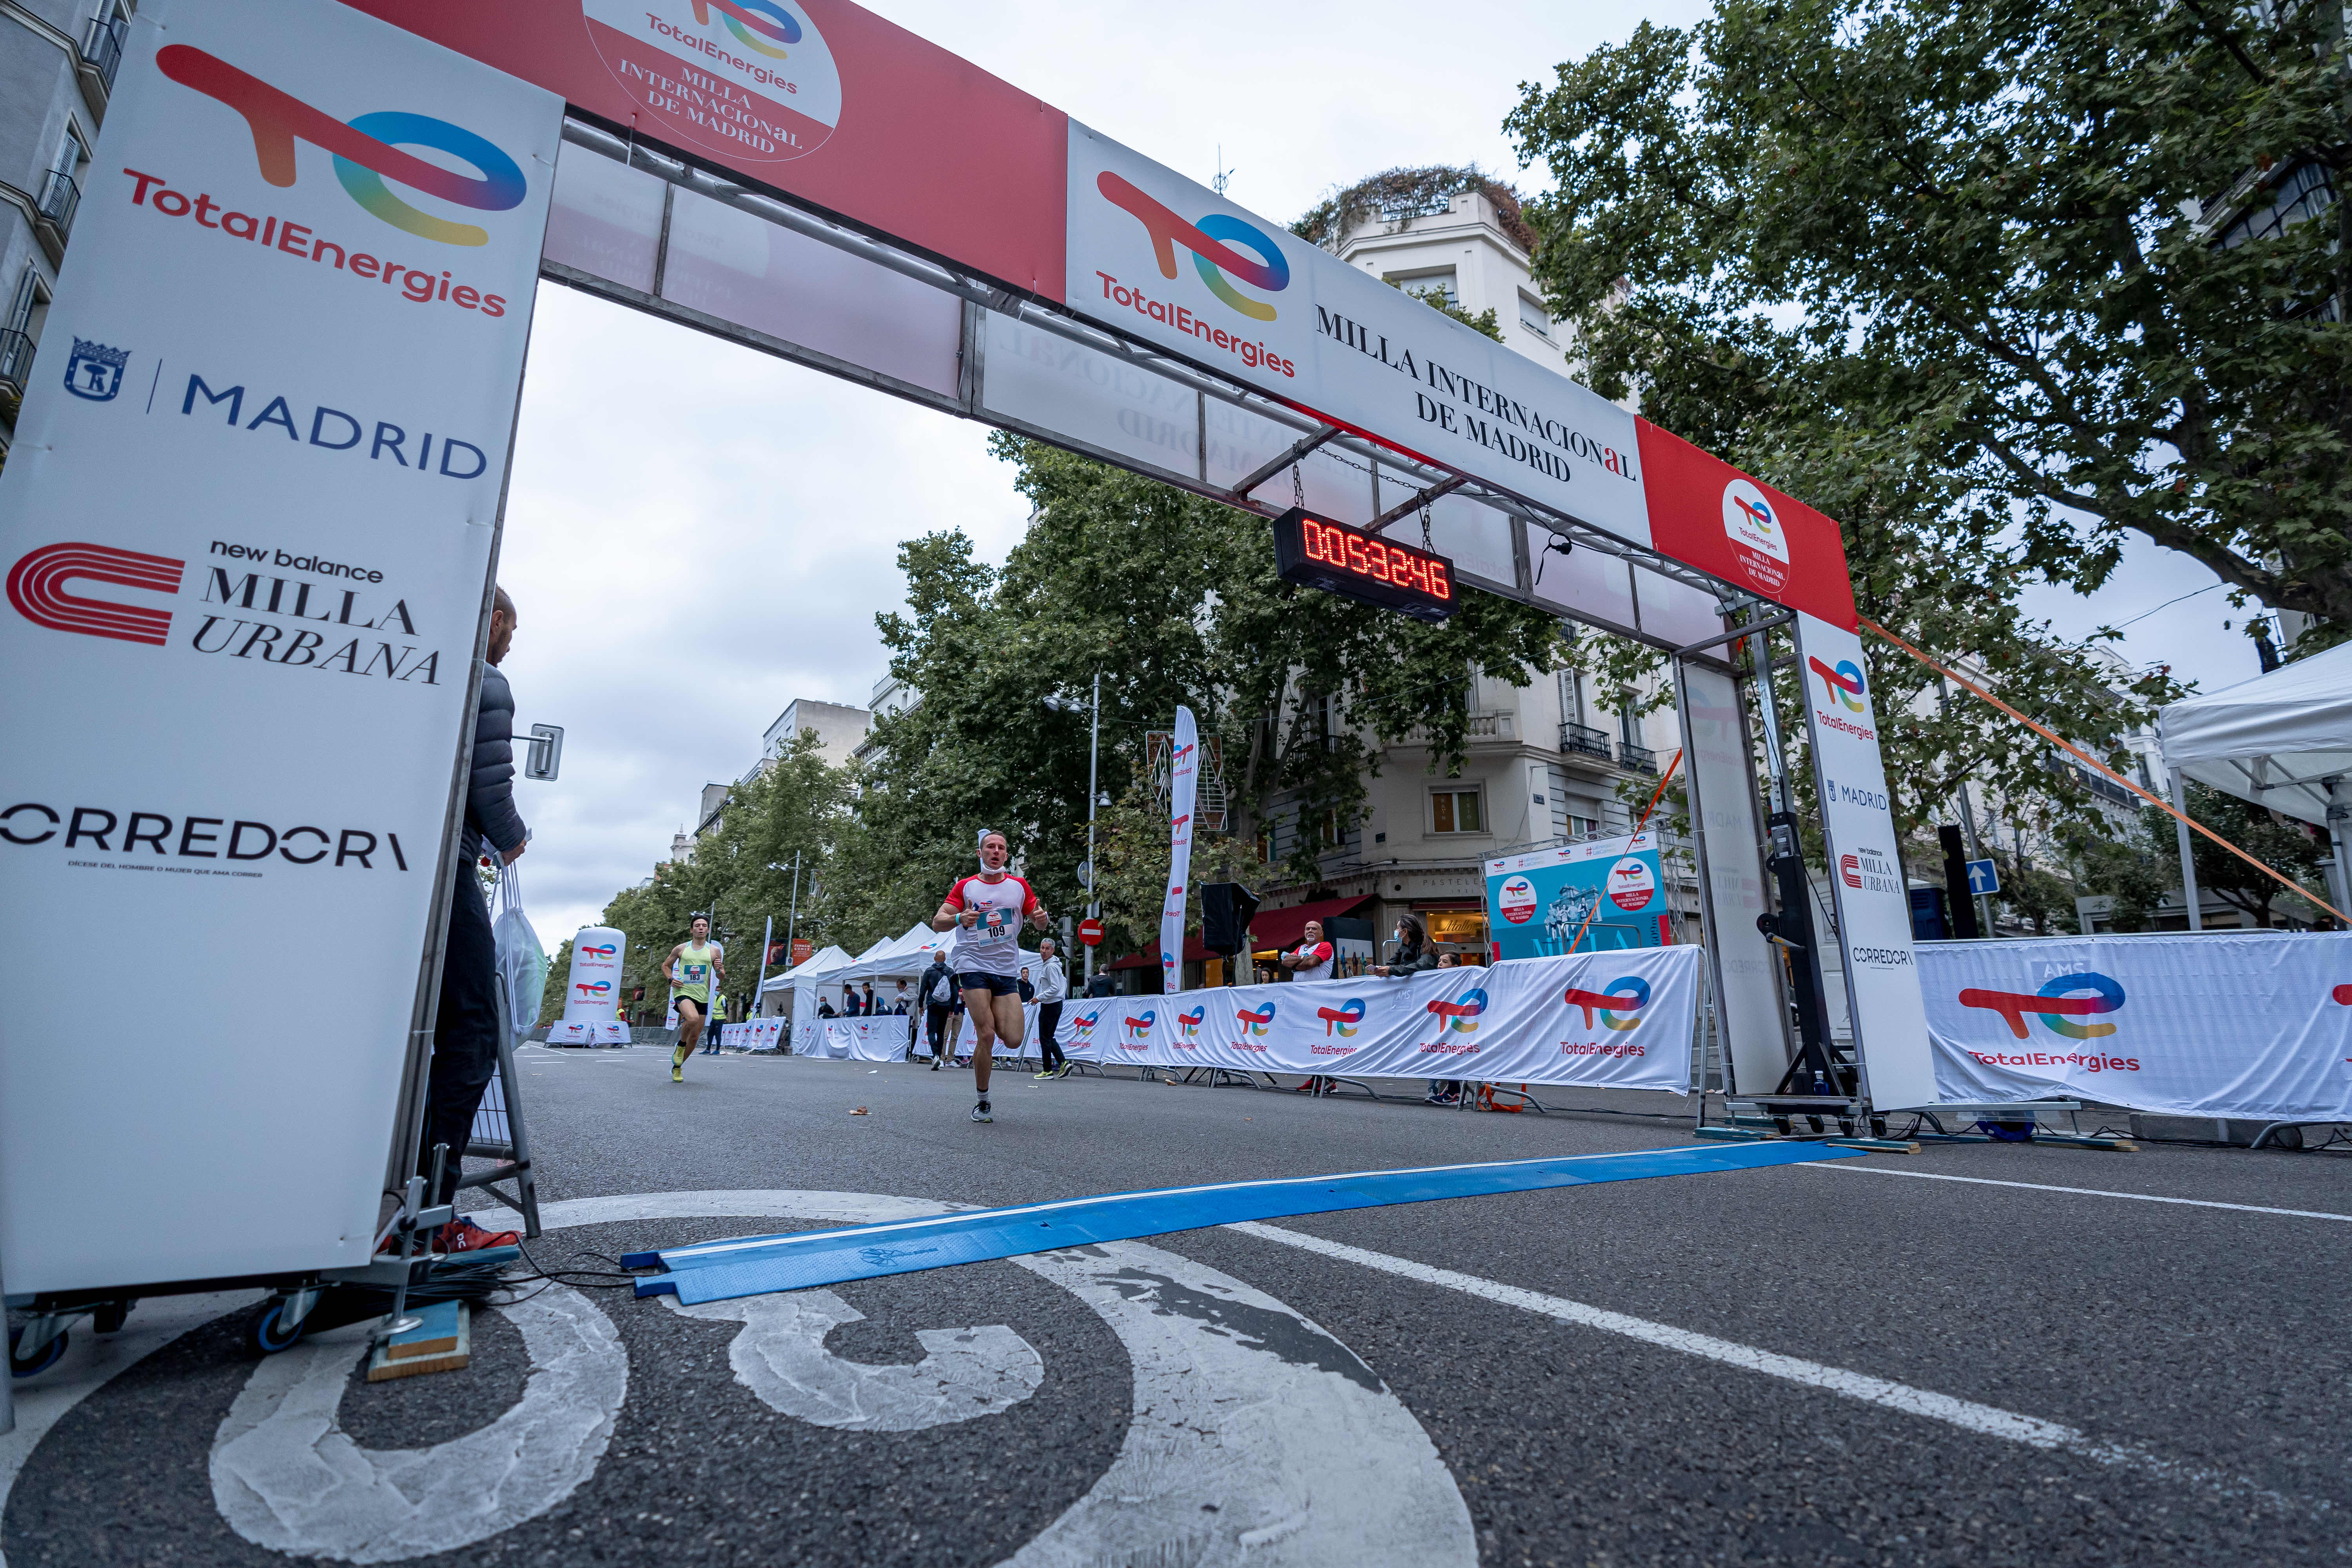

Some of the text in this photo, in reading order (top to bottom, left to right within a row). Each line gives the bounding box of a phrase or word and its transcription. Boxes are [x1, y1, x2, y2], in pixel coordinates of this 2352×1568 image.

[646, 12, 797, 94] TotalEnergies
[681, 66, 752, 110] MILLA
[647, 90, 775, 154] DE MADRID
[123, 168, 506, 317] TotalEnergies
[1096, 270, 1295, 378] TotalEnergies
[1315, 304, 1420, 381] MILLA
[182, 374, 487, 479] MADRID
[1415, 390, 1570, 483] DE MADRID
[1739, 526, 1777, 551] TotalEnergies
[210, 540, 383, 583] new balance
[1752, 551, 1770, 565] MILLA
[1748, 568, 1780, 586] DE MADRID
[200, 566, 421, 636] MILLA
[192, 615, 441, 685] URBANA
[1817, 710, 1874, 740] TotalEnergies
[1842, 785, 1886, 810] MADRID
[1866, 848, 1882, 856] balance
[1860, 857, 1892, 875] MILLA
[1864, 875, 1900, 894] URBANA
[987, 926, 1005, 938] 109
[1311, 1045, 1357, 1057] TotalEnergies
[1418, 1042, 1479, 1055] TotalEnergies
[1560, 1041, 1644, 1058] TotalEnergies
[1968, 1051, 2140, 1073] TotalEnergies
